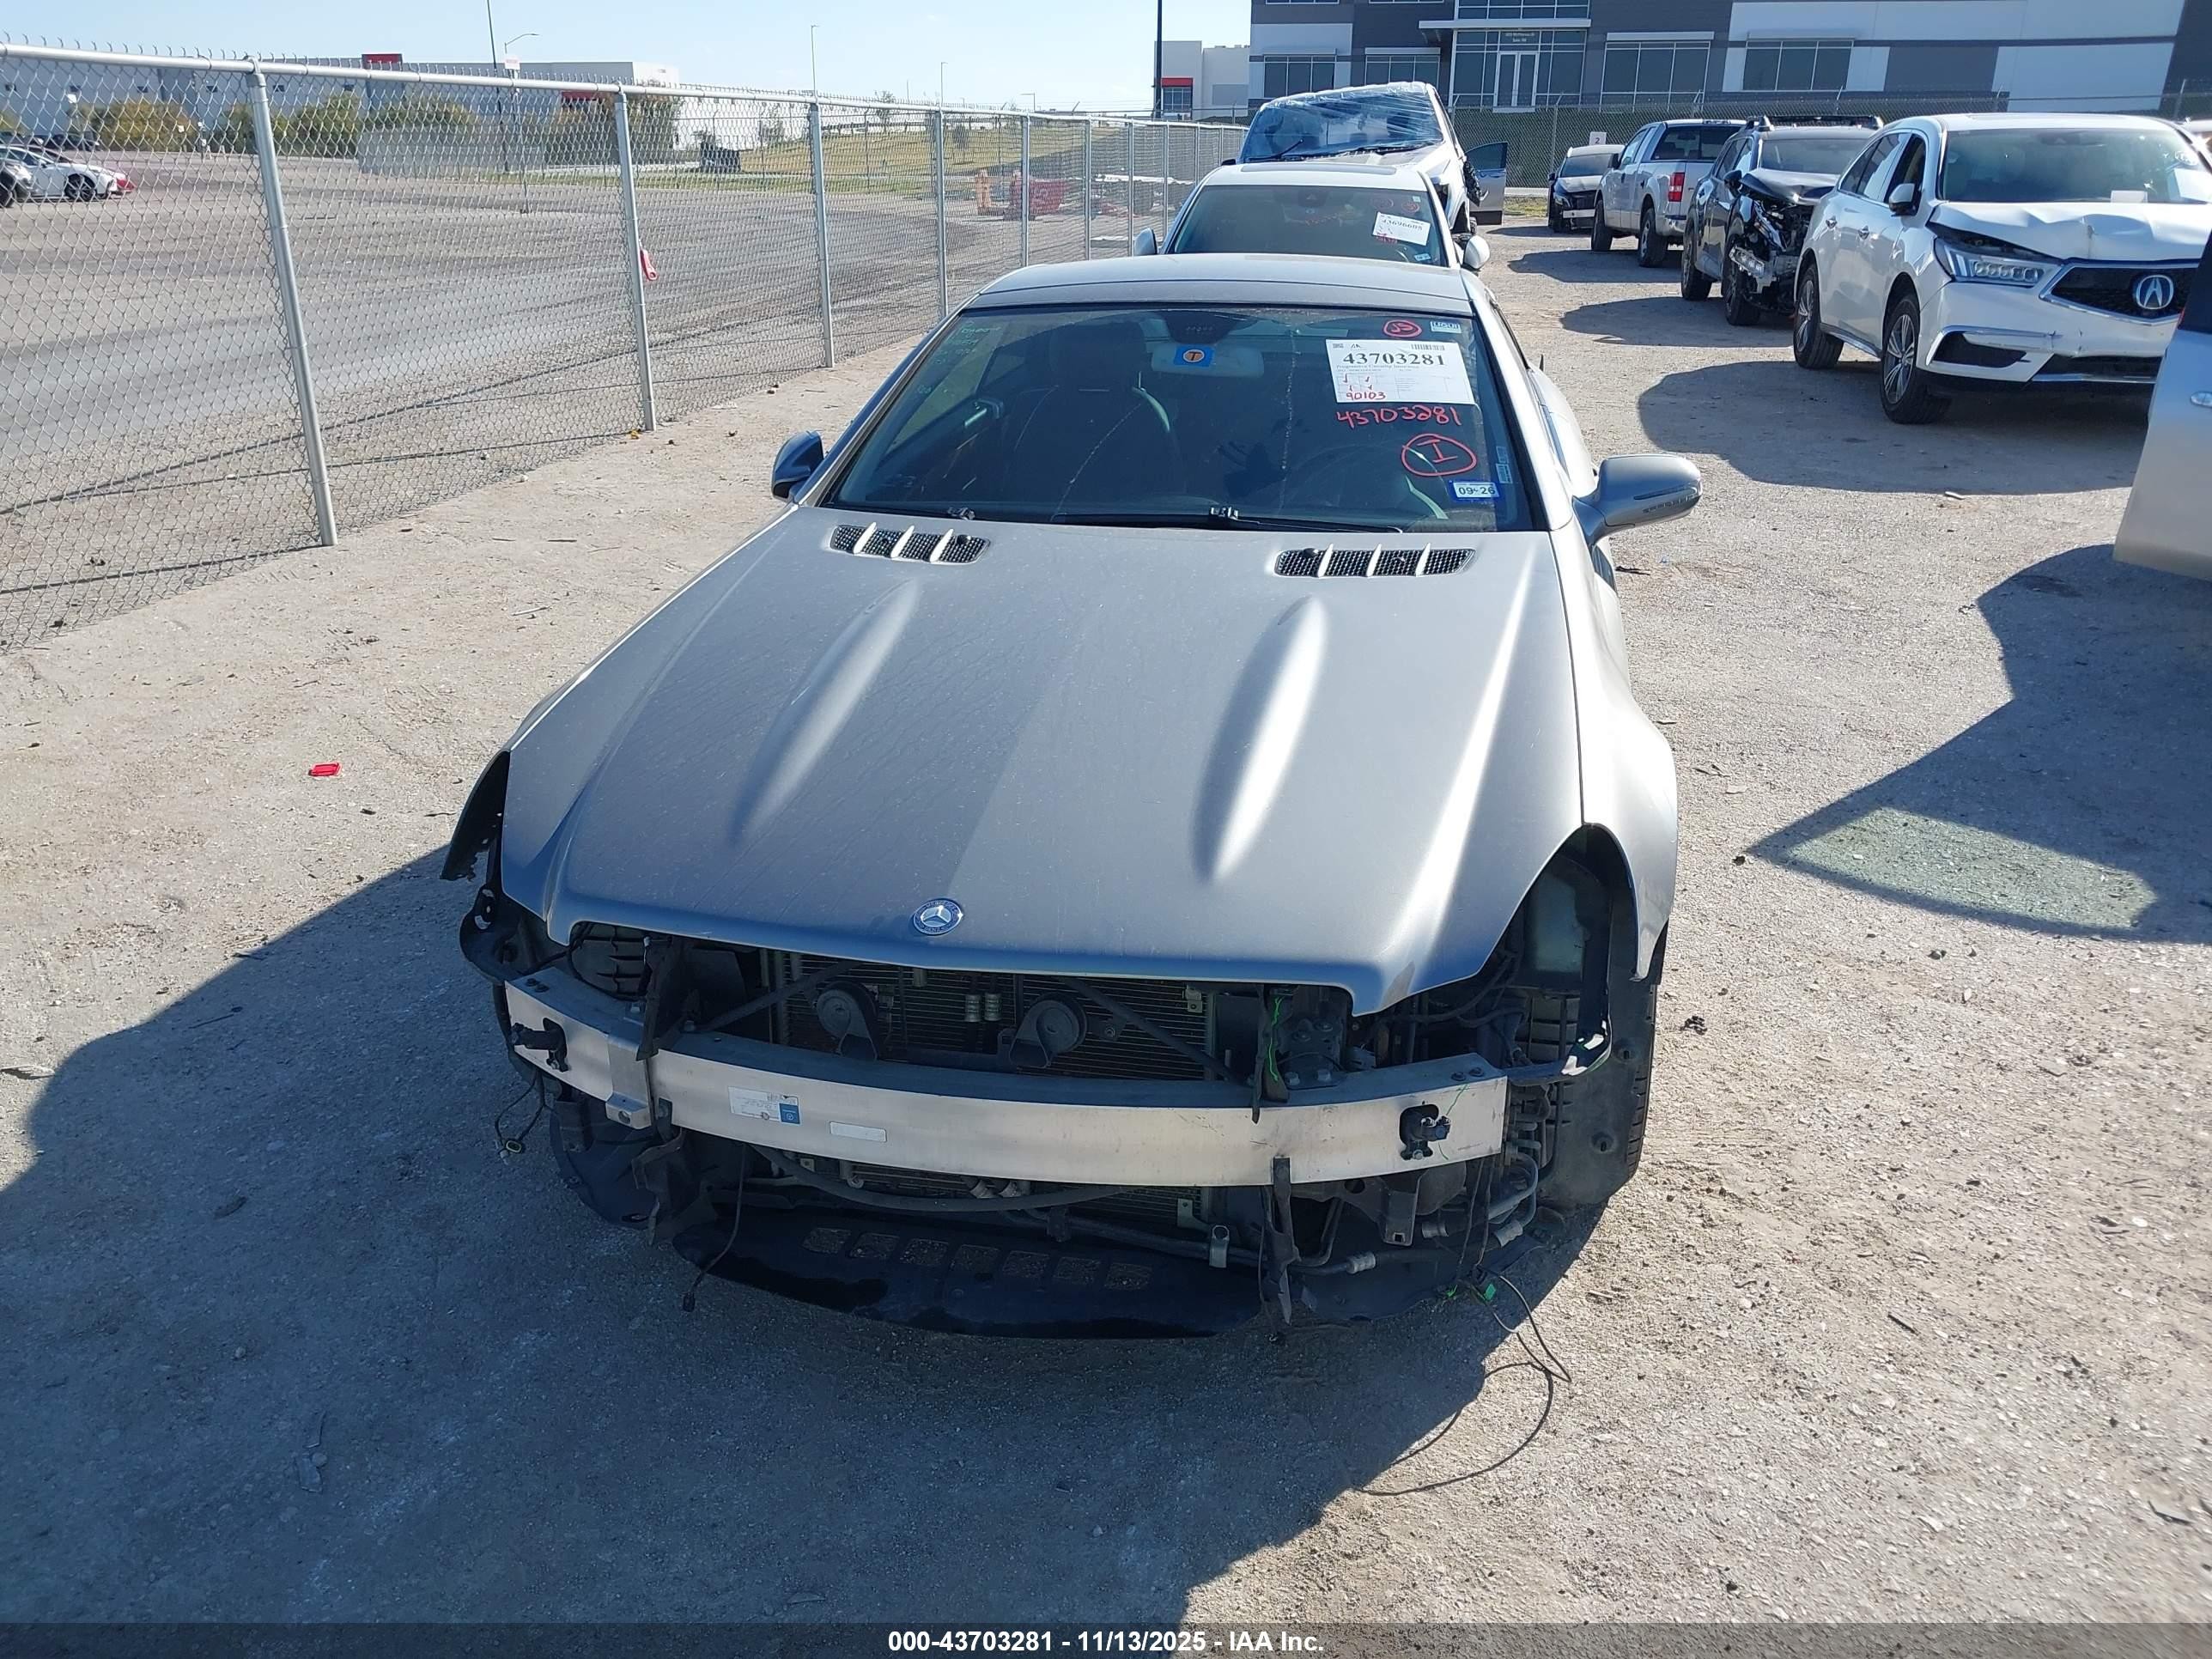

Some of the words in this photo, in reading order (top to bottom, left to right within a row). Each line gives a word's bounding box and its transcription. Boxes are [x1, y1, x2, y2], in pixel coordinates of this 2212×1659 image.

[1343, 353, 1446, 366] 43703281
[1346, 392, 1386, 400] 90103
[1336, 404, 1462, 428] 43703281
